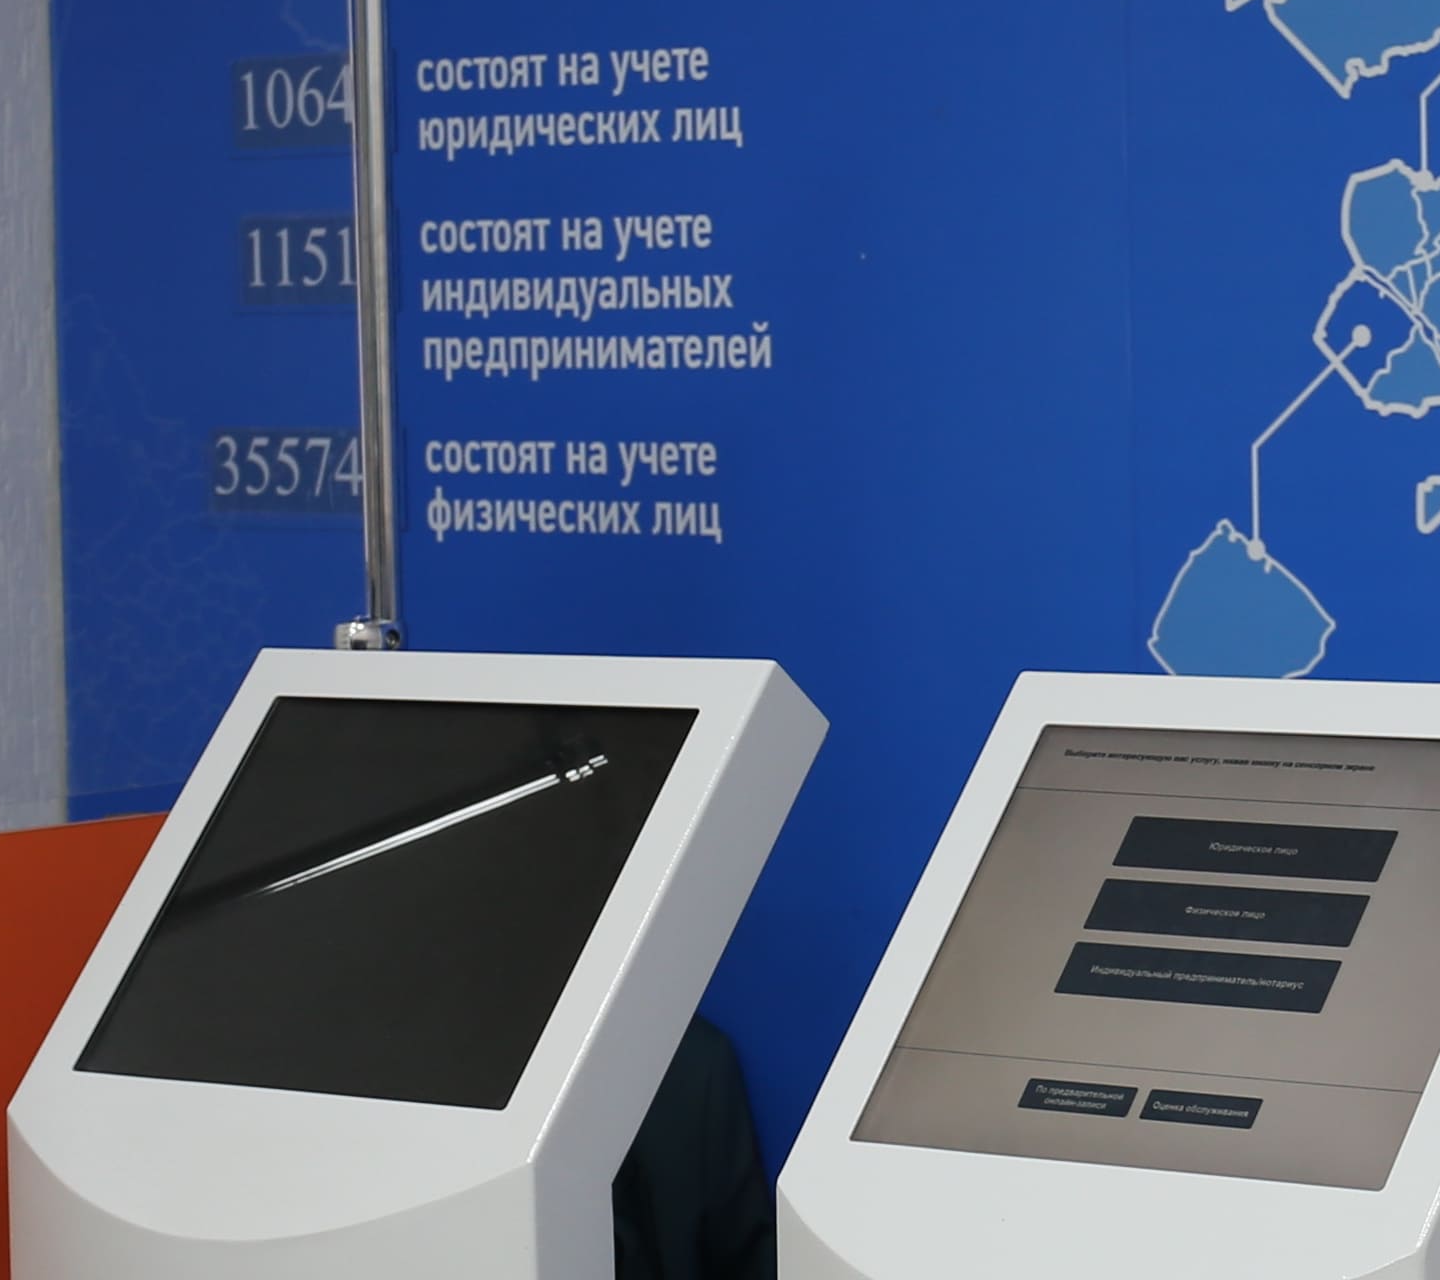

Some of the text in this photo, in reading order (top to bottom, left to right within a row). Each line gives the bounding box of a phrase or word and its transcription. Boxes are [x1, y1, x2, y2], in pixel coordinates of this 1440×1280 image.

[417, 46, 710, 97] состоят на учете
[419, 106, 743, 161] юридических лиц
[420, 213, 712, 262] состоят на учете
[422, 274, 734, 321] индивидуальных
[423, 321, 773, 381] предпринимателей
[425, 439, 717, 486] состоят на учете
[427, 486, 722, 543] физических лиц
[1208, 841, 1299, 856] Юридическое лицо
[1184, 905, 1266, 920] Физическое лицо
